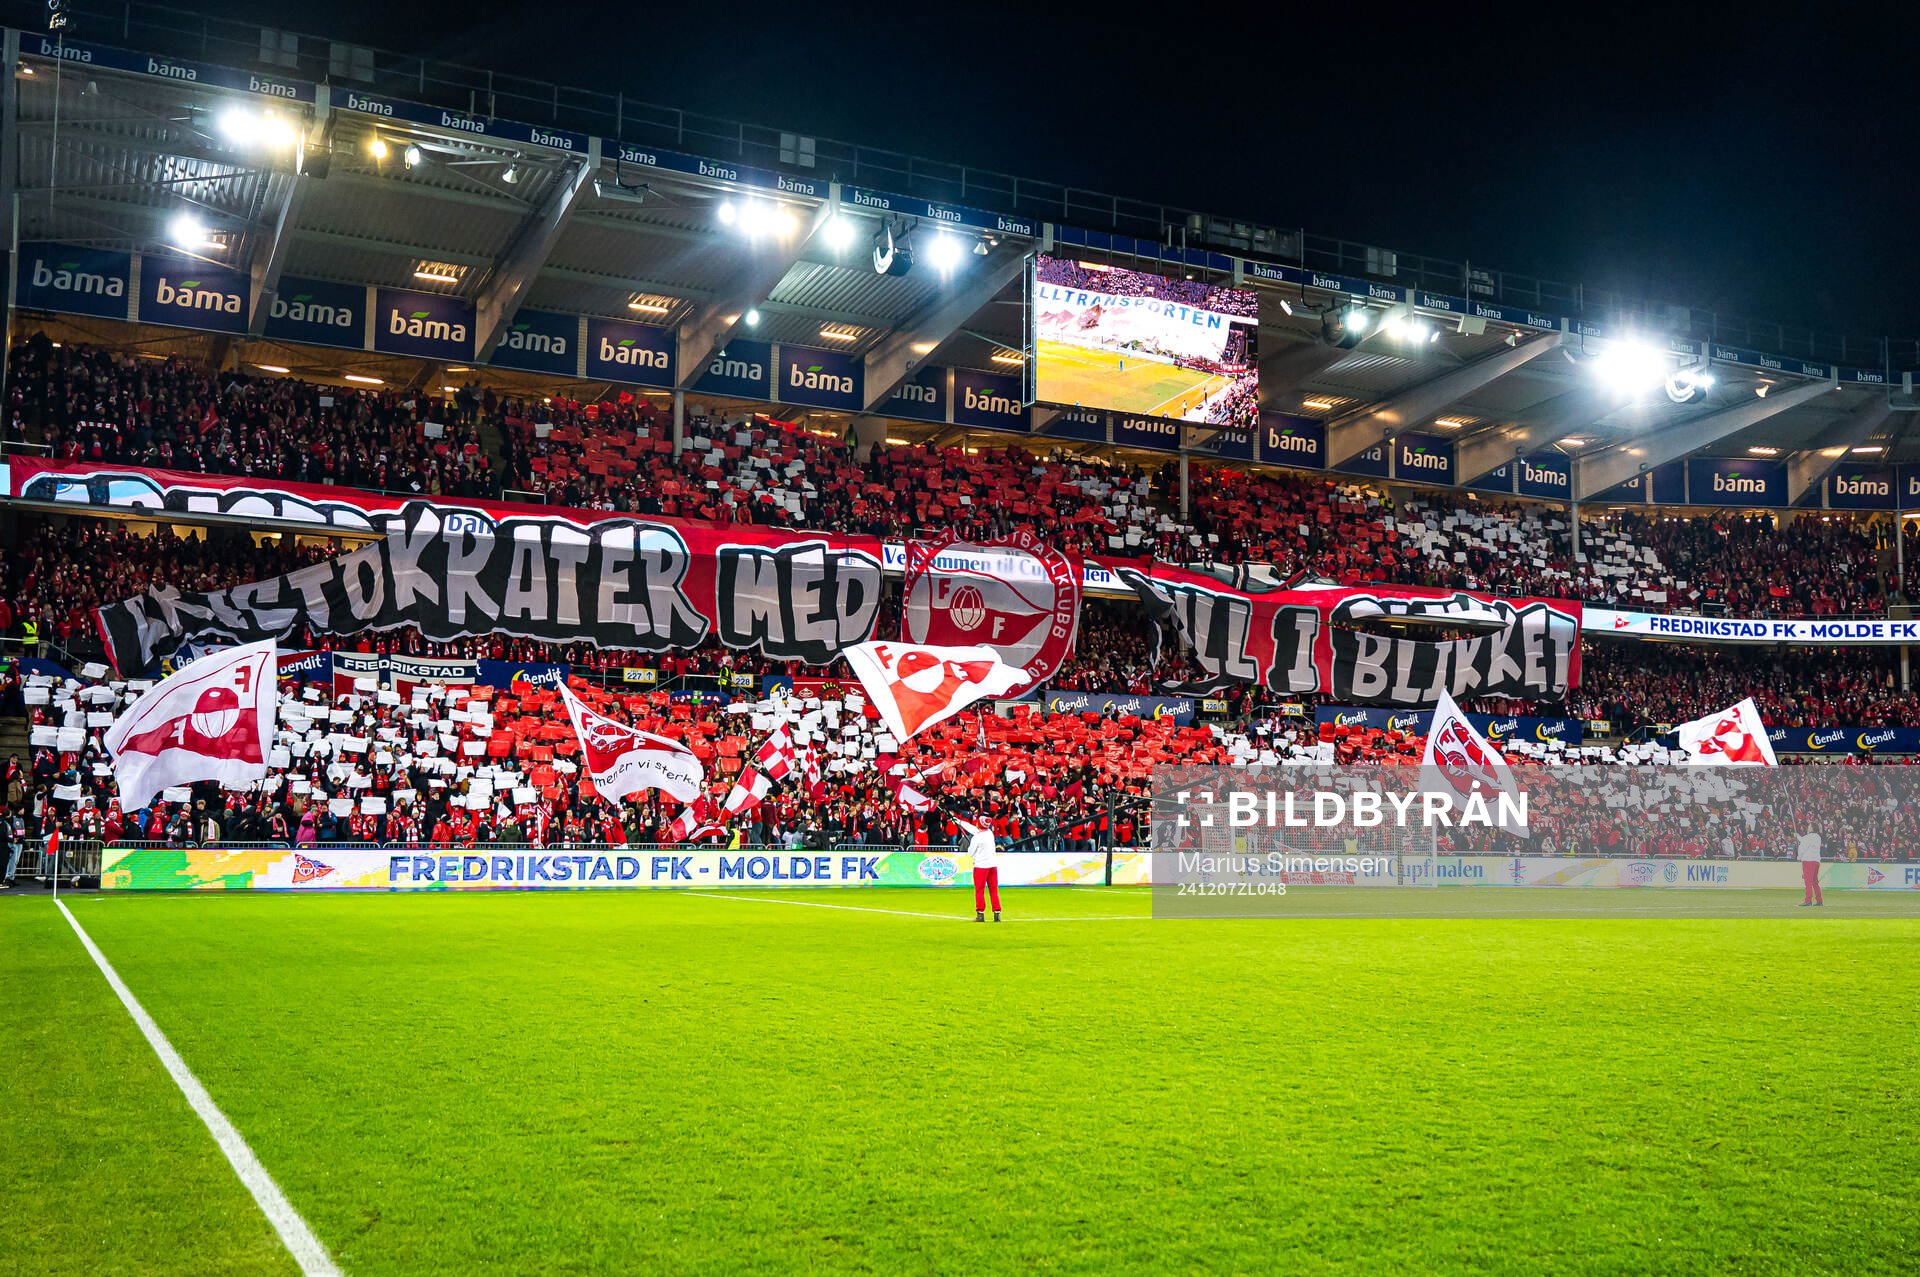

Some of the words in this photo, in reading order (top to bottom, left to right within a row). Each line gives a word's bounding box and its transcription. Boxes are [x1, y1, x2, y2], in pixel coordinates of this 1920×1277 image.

[40, 39, 92, 63] bama
[147, 58, 197, 81] bama
[249, 76, 297, 98] bama
[347, 94, 393, 116] bama
[441, 112, 485, 133] bama
[530, 128, 573, 150] bama
[699, 161, 738, 180] bama
[778, 175, 815, 195] bama
[854, 190, 890, 209] bama
[927, 204, 962, 222] bama
[997, 217, 1031, 235] bama
[33, 258, 124, 297] bama
[1254, 263, 1283, 280] bama
[1312, 274, 1341, 290] bama
[156, 277, 241, 314] bama
[1368, 284, 1396, 301] bama
[1424, 295, 1450, 310] bama
[1476, 304, 1502, 320] bama
[390, 309, 467, 343] bama
[1527, 313, 1552, 329] bama
[600, 337, 669, 370] bama
[1671, 340, 1694, 353] bama
[1716, 348, 1738, 362] bama
[706, 357, 763, 381] ama
[1760, 356, 1782, 370] bama
[1802, 363, 1824, 377] bama
[790, 363, 854, 394] bama
[1857, 371, 1883, 383] bama
[964, 386, 1022, 416] bama
[1268, 427, 1317, 454] bama
[1403, 446, 1448, 471] bama
[1525, 462, 1567, 487] bama
[1713, 472, 1766, 493] bama
[1836, 475, 1889, 496] bama
[732, 549, 881, 651] MED
[1650, 617, 1767, 637] FREDRIKSTAD
[1773, 623, 1797, 637] FK
[1811, 624, 1884, 638] MOLDE
[1890, 624, 1917, 638] FK
[344, 658, 465, 677] FREDRIKSTAD
[627, 672, 643, 681] 227
[734, 678, 750, 686] 228
[1058, 696, 1089, 711] Bendit
[1162, 701, 1191, 715] Bendit
[1341, 710, 1368, 725] Bendit
[1394, 714, 1419, 728] Bendit
[1494, 718, 1518, 734] Bendit
[1542, 720, 1565, 735] Bendit
[1815, 729, 1845, 745] Bendit
[1865, 729, 1896, 745] Bendit
[389, 856, 640, 881] FREDRIKSTAD
[651, 856, 693, 880] FK
[719, 856, 831, 880] MOLDE
[841, 856, 880, 880] FK
[1687, 864, 1715, 882] KIWI
